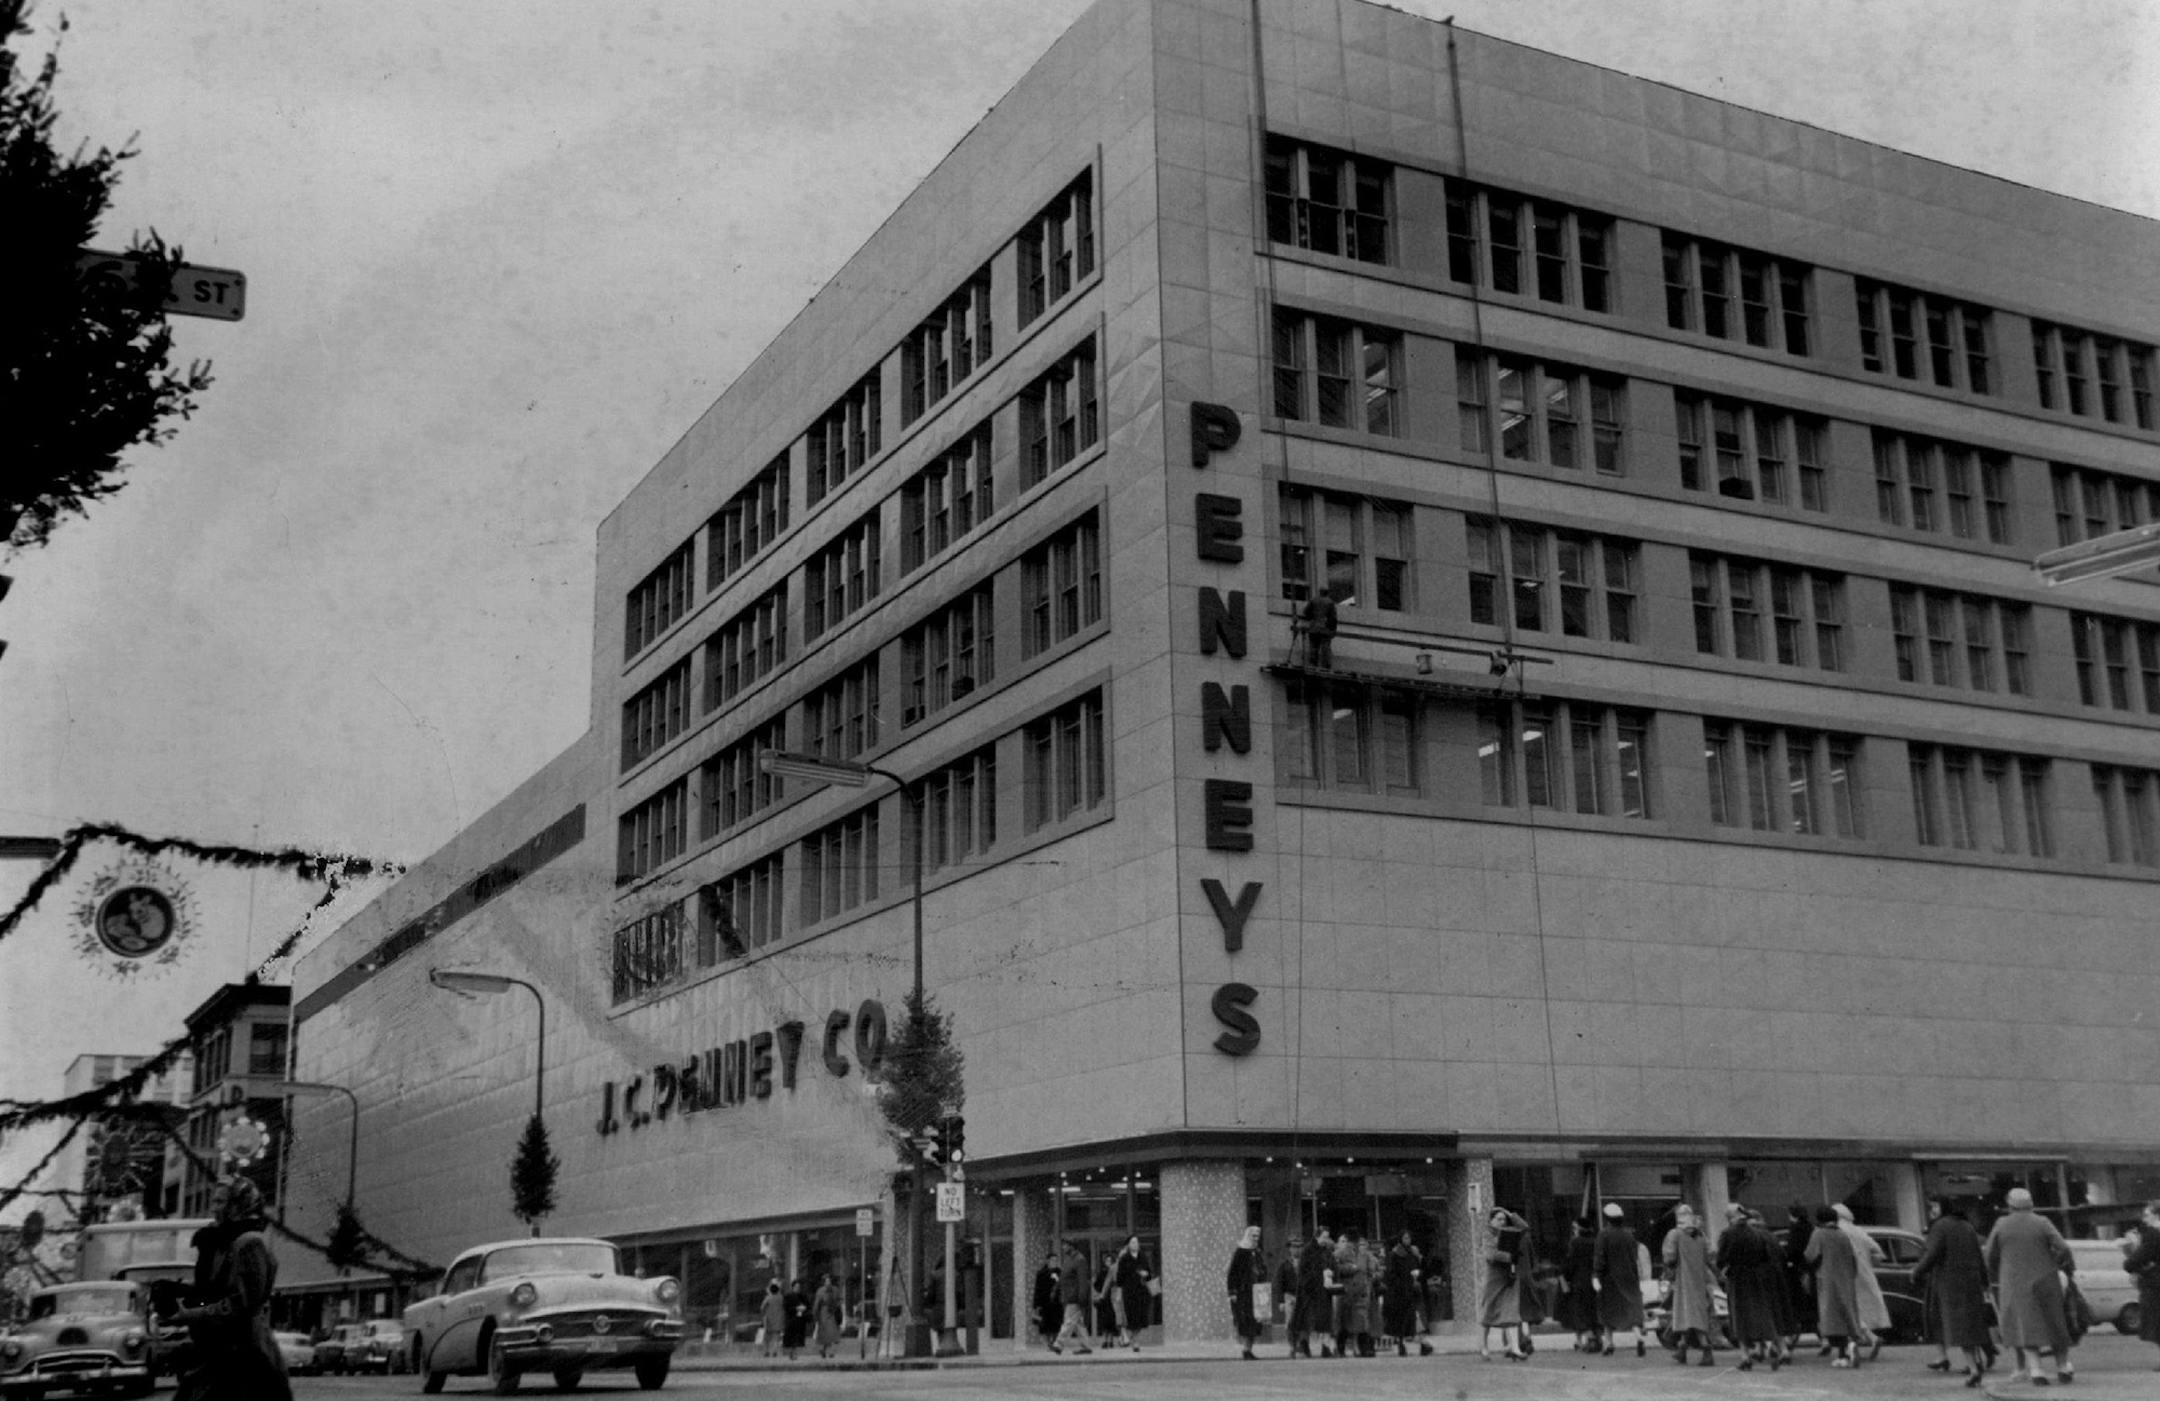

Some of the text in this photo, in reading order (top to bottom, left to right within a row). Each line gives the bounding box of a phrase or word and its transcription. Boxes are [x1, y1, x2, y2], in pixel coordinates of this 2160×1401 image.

[194, 280, 230, 304] ST
[1191, 401, 1263, 1056] PENNEYS
[944, 1186, 957, 1196] NO
[940, 1197, 960, 1207] LEFT
